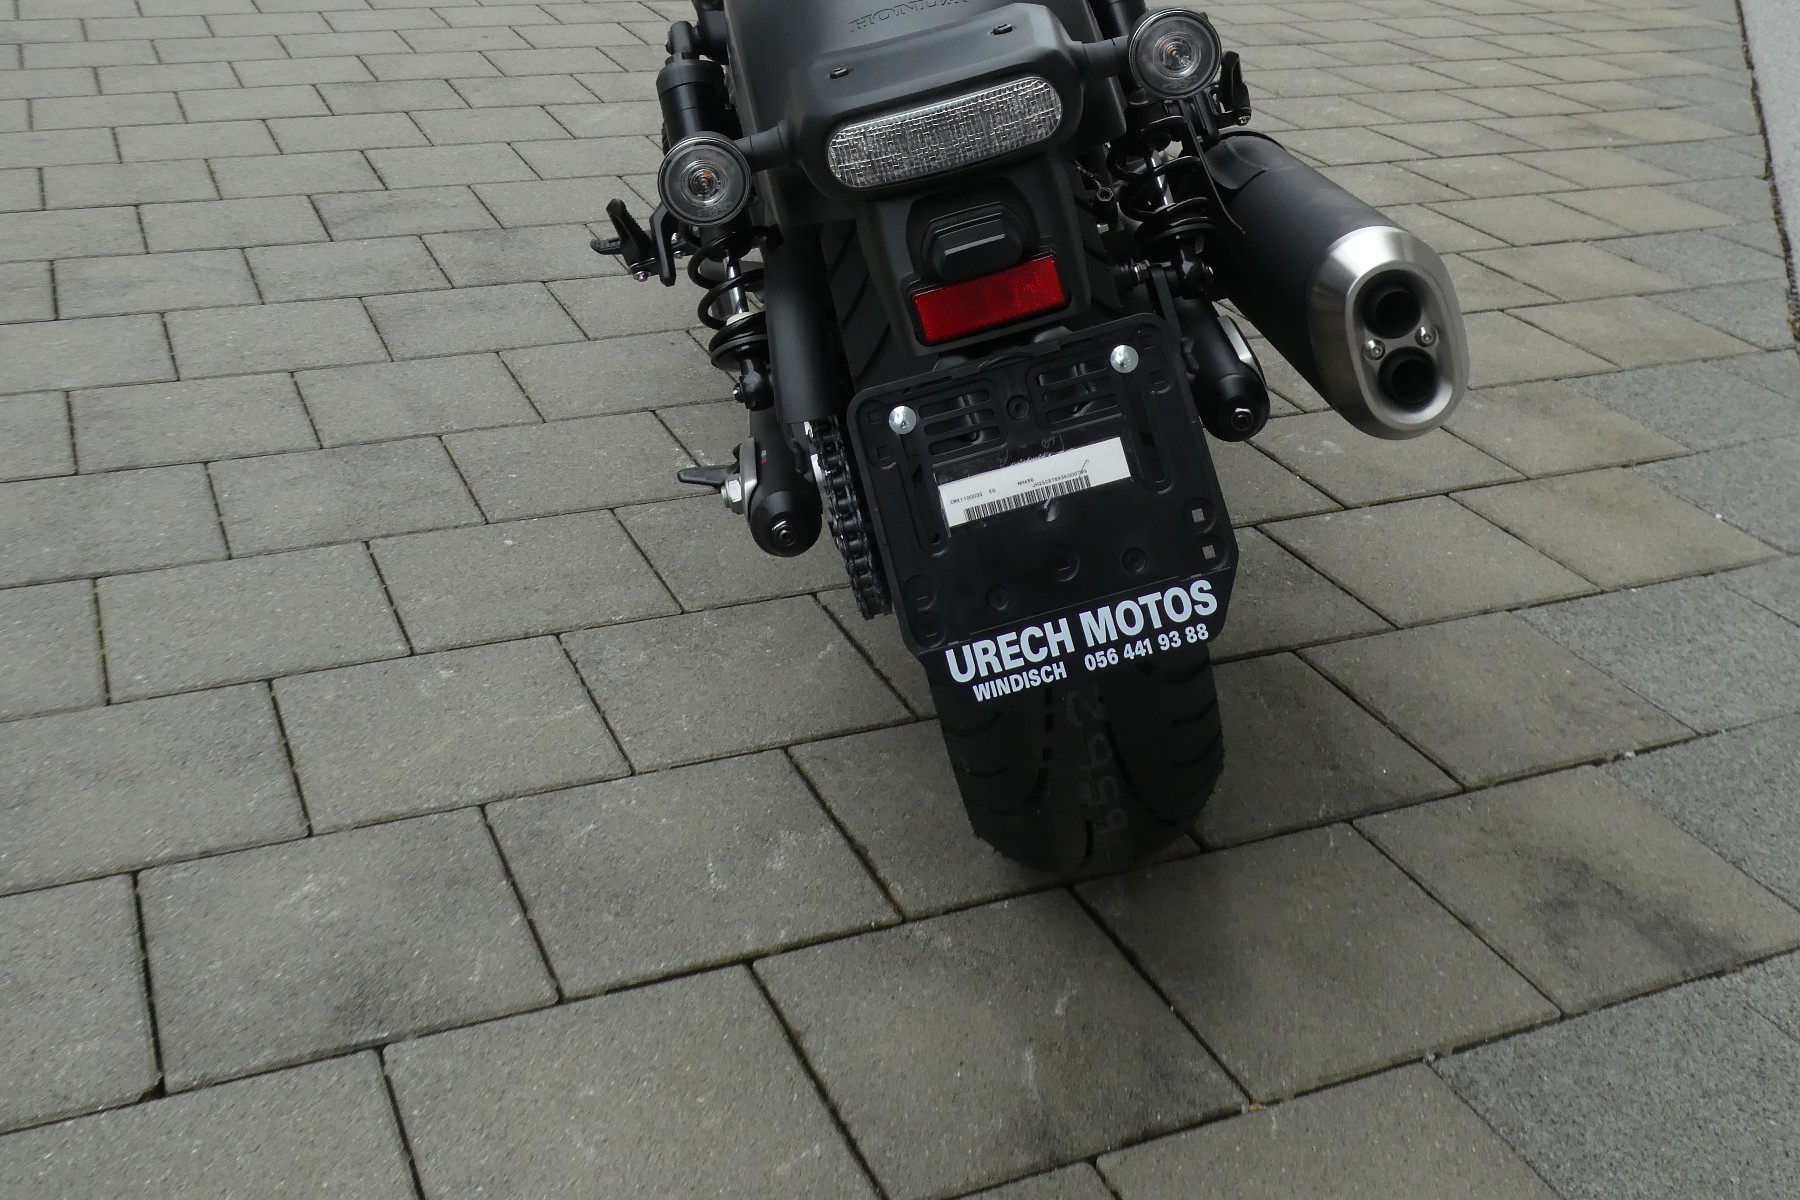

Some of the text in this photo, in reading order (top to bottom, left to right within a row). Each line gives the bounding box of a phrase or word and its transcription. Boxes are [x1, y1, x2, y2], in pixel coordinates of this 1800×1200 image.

[945, 580, 1217, 682] URECH MOTOS
[973, 624, 1208, 701] WINDISCH 056 441 93 88
